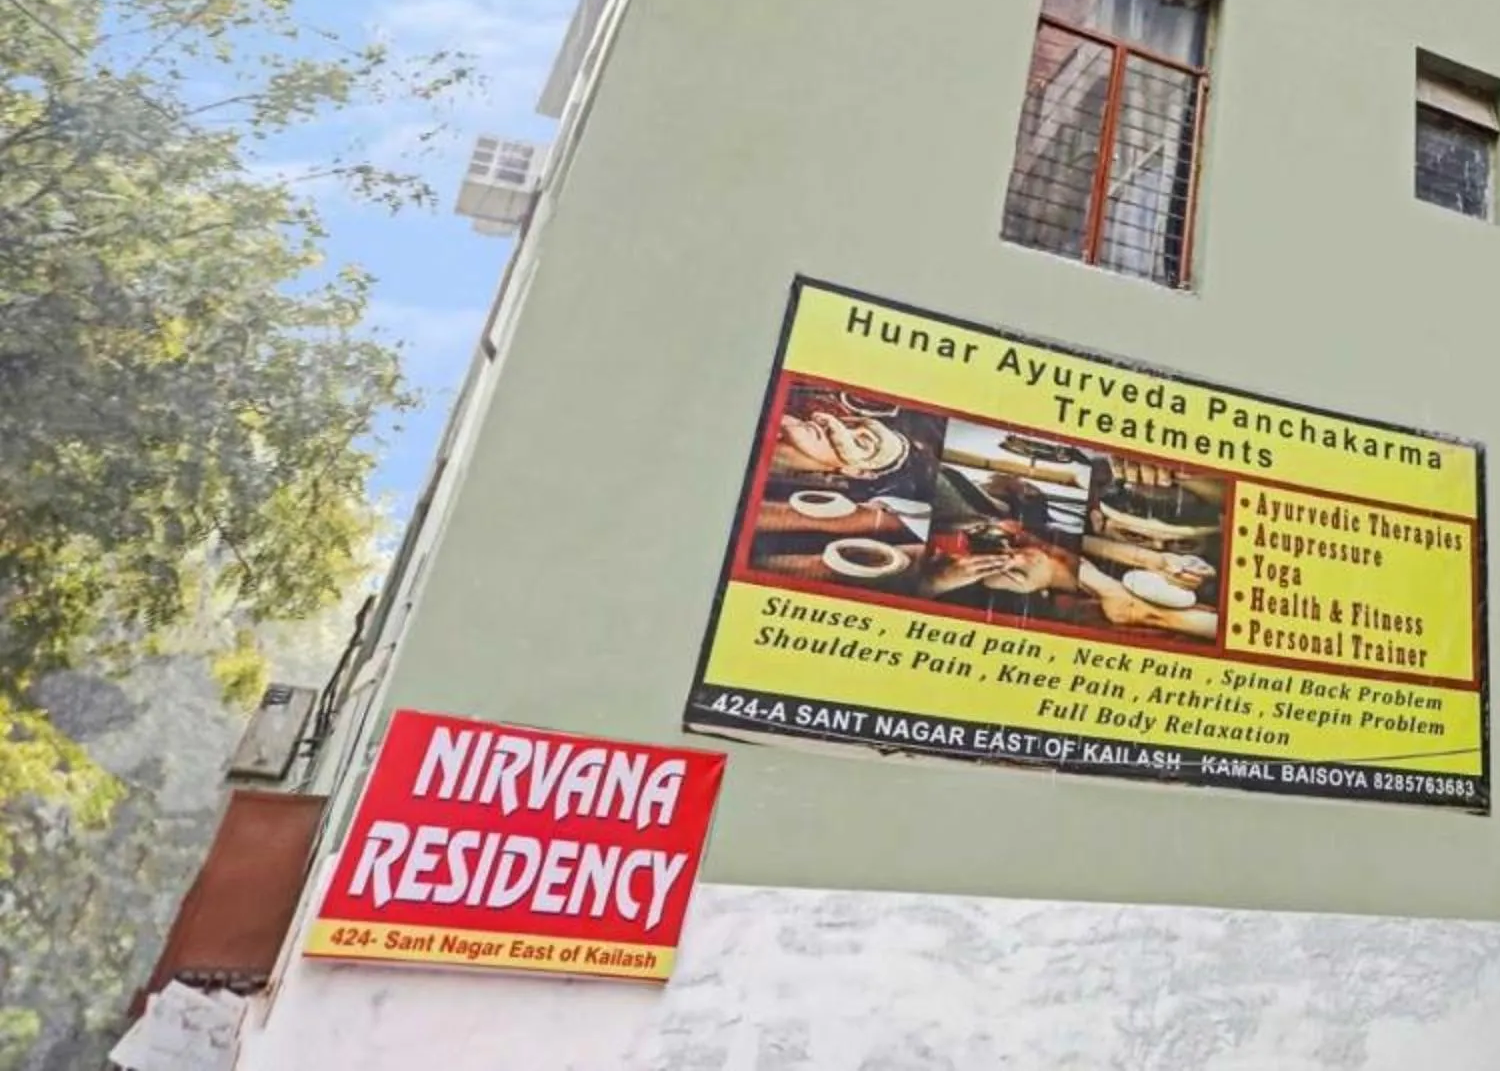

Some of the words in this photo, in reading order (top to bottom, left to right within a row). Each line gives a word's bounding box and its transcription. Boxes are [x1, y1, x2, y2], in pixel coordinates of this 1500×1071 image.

[846, 306, 979, 365] Hunar
[997, 348, 1188, 415] Ayurveda
[1207, 397, 1443, 470] Panchakarma
[1054, 396, 1275, 469] Treatments
[1254, 523, 1383, 566] Acupressure
[1256, 492, 1360, 532] Ayurvedic
[1368, 512, 1463, 551] Therapies
[1253, 555, 1301, 588] Yoga
[1248, 620, 1343, 657] Personal
[1351, 634, 1427, 668] Trainer
[1250, 587, 1321, 621] Health
[1329, 600, 1343, 623] &
[1351, 602, 1423, 636] Fitness
[755, 627, 904, 666] Shoulders
[911, 651, 972, 678] Pain
[996, 659, 1060, 690] Knee
[1070, 674, 1125, 699] Pain
[1147, 686, 1252, 715] Arthritis
[1272, 702, 1352, 727] Sleepin
[1360, 711, 1445, 736] Problem
[762, 597, 872, 631] Sinuses
[906, 620, 974, 648] Head
[982, 636, 1042, 658] pain
[1073, 647, 1132, 672] Neck
[1140, 657, 1193, 680] Pain
[1221, 669, 1292, 694] Spinal
[1300, 678, 1350, 700] Back
[1358, 686, 1442, 711] Problem
[712, 693, 786, 722] 424-A
[795, 704, 869, 733] SANT
[876, 716, 965, 747] NAGAR
[973, 730, 1038, 754] EAST
[1045, 738, 1076, 759] OF
[1084, 743, 1180, 770] KAILASH
[1201, 754, 1274, 780] KAMAL
[1281, 765, 1368, 789] BAISOYA
[1373, 772, 1475, 797] 8285763683
[1037, 698, 1088, 722] Full
[1095, 707, 1156, 734] Body
[1165, 714, 1290, 745] Relaxation
[413, 726, 687, 830] NIRVANA
[348, 820, 688, 930] RESIDENCY
[384, 930, 434, 952] Sant
[440, 934, 501, 960] Nagar
[508, 941, 555, 961] East
[560, 943, 582, 962] of
[584, 947, 656, 969] Kailash
